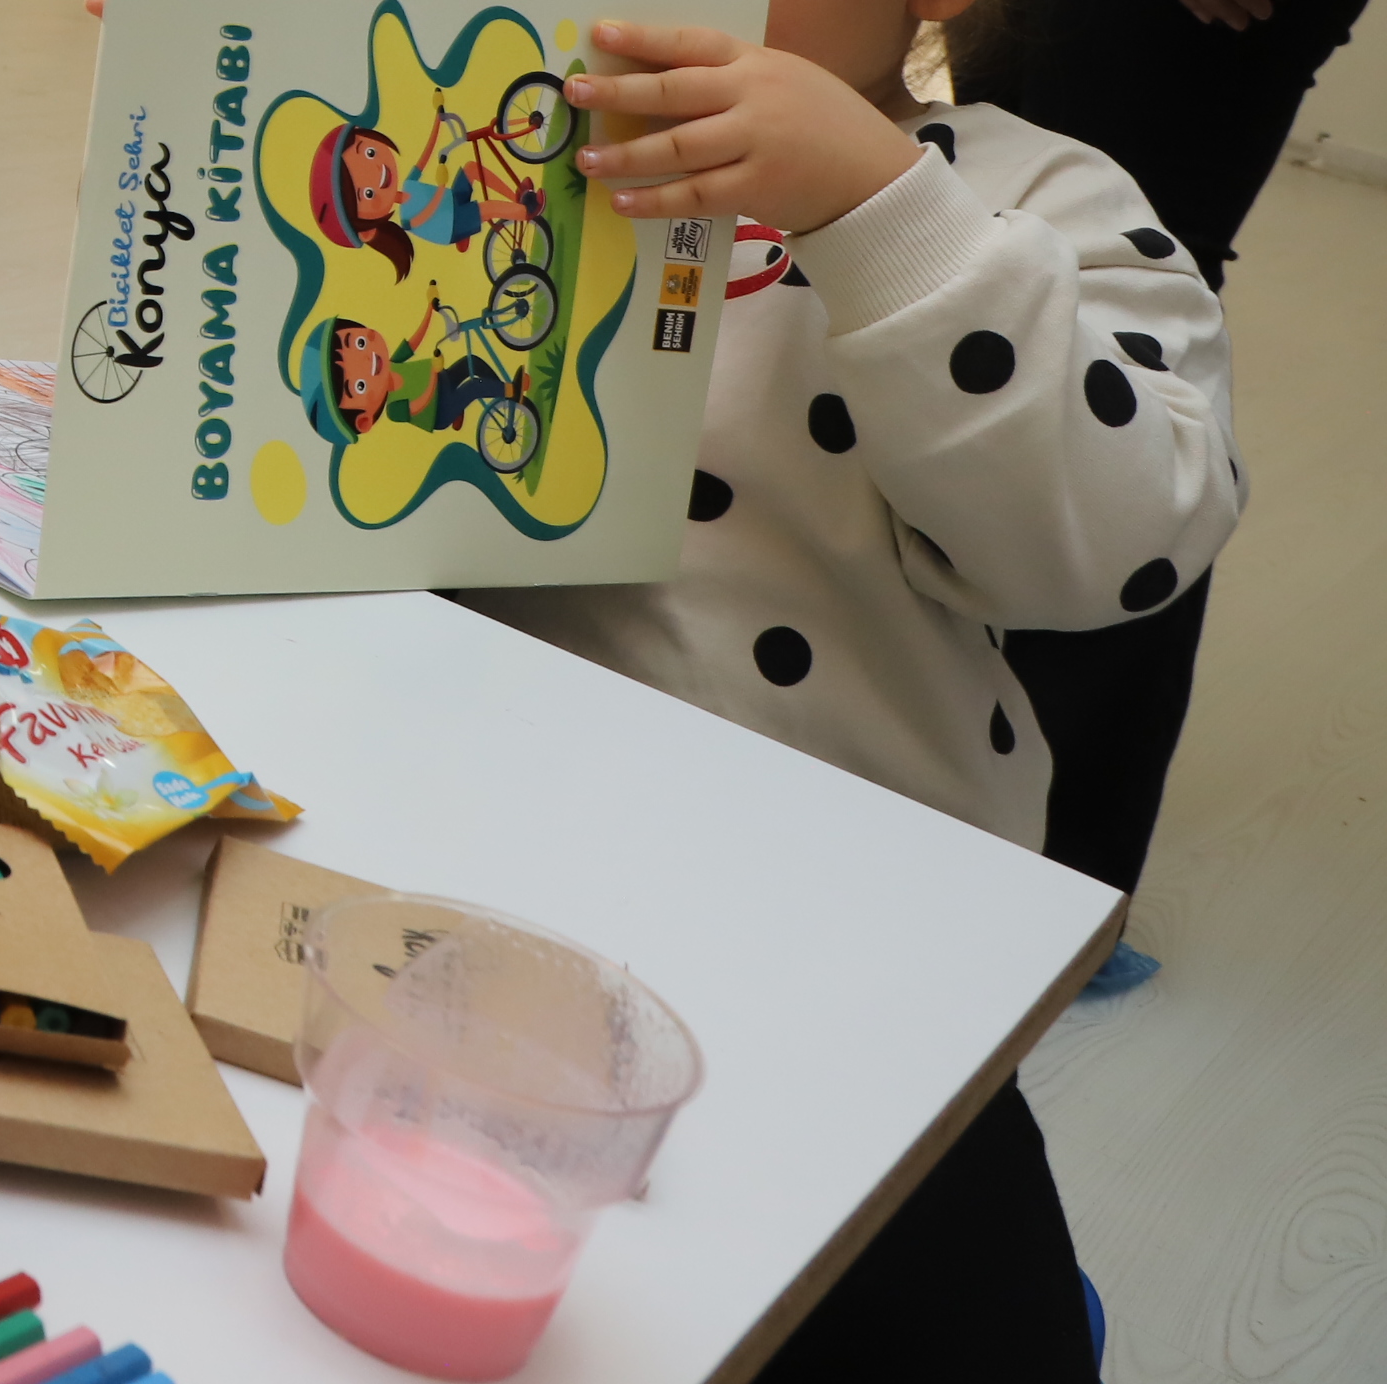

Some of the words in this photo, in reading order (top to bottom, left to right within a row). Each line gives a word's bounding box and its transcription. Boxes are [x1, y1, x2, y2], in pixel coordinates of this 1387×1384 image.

[197, 24, 253, 222] KİTABI
[114, 142, 195, 368] Konya
[190, 244, 240, 501] BOYAMA
